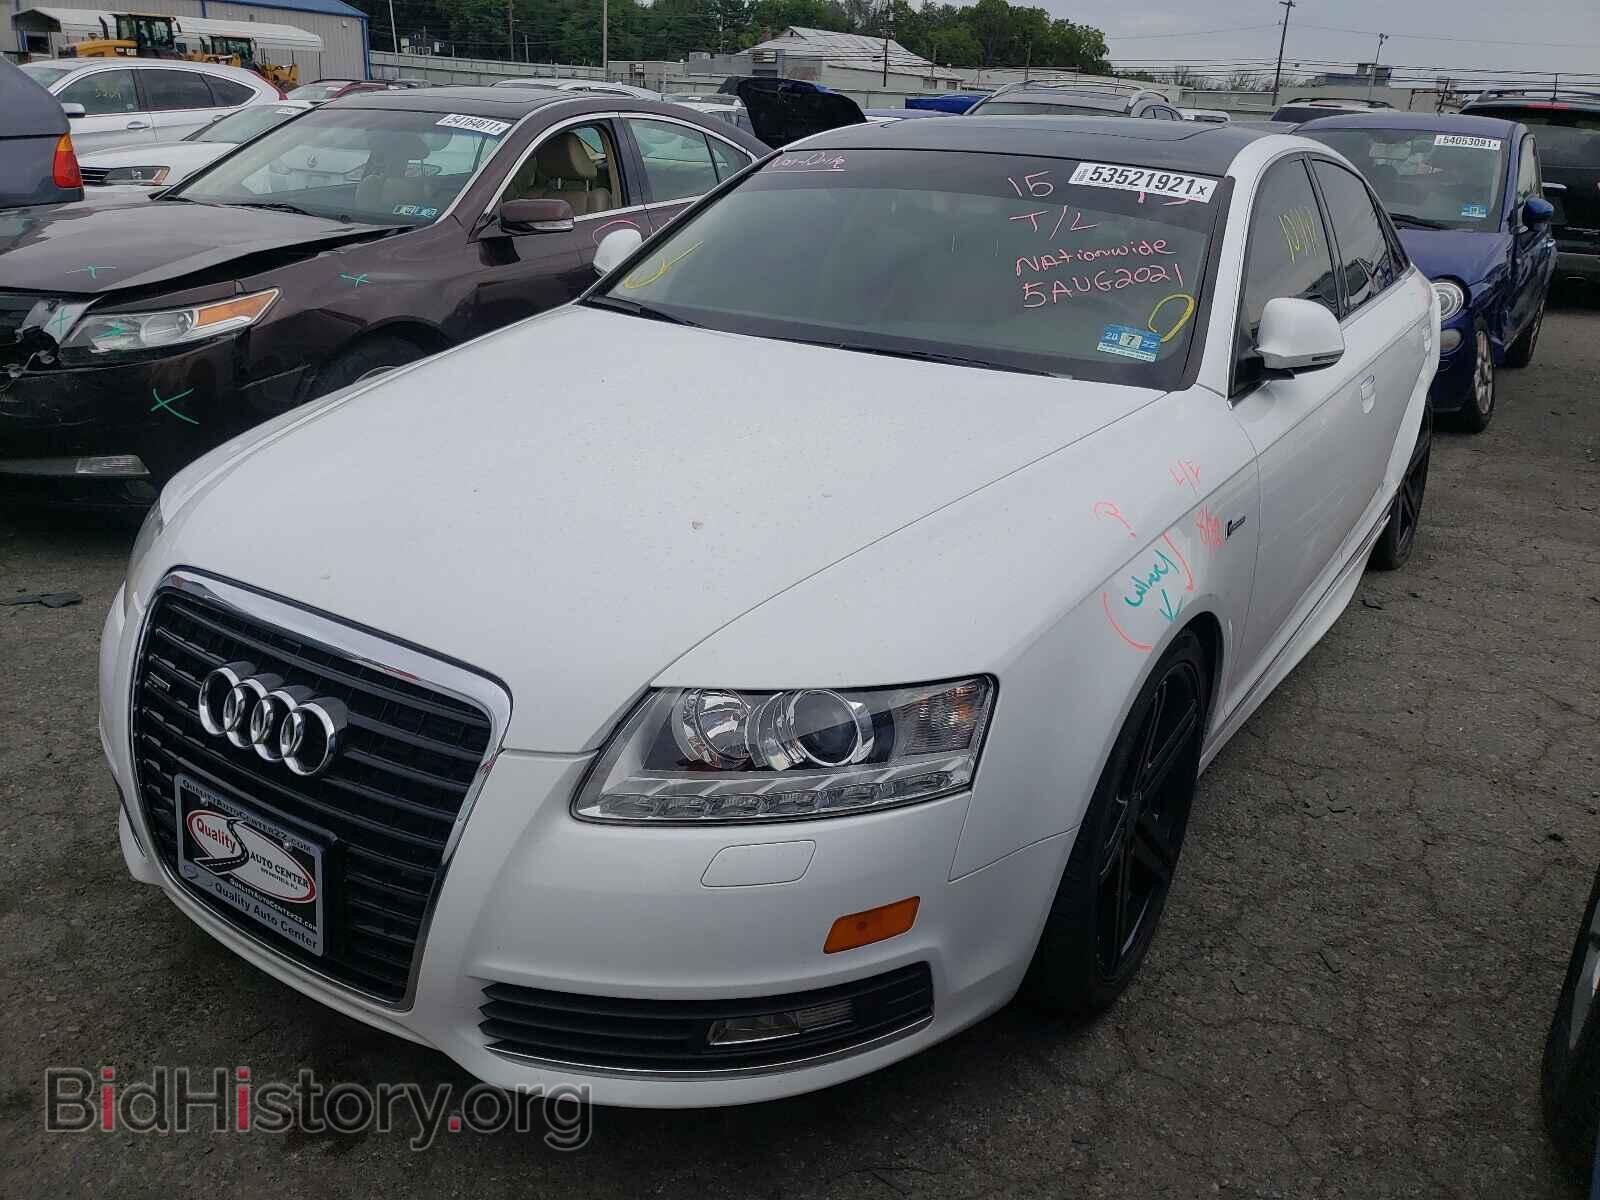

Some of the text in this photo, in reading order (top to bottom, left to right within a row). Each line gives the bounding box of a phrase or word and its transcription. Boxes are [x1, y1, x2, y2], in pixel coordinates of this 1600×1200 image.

[1105, 332, 1118, 341] 20
[1128, 335, 1136, 346] 7
[197, 818, 236, 854] Quality
[250, 852, 310, 889] AUTO CENTER
[215, 882, 318, 949] Quality Auto Center
